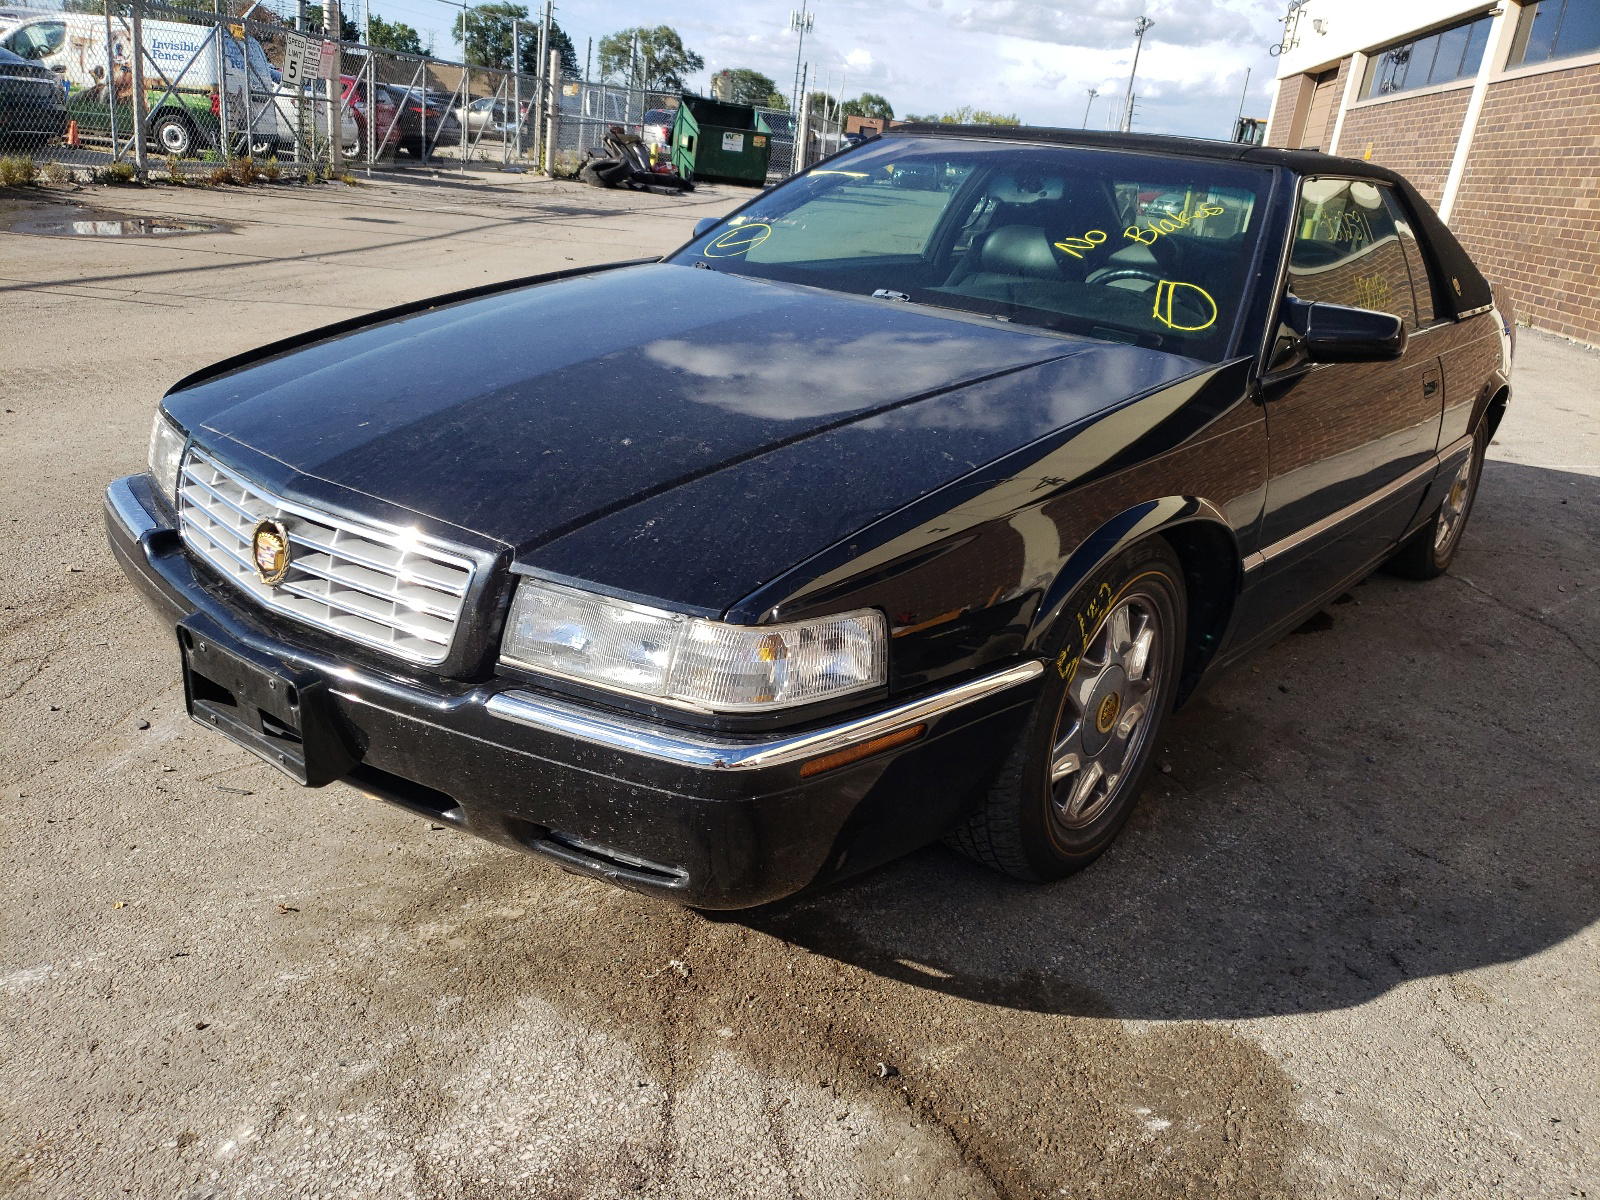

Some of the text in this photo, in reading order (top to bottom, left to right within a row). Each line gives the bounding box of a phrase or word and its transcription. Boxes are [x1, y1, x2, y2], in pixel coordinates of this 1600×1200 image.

[152, 38, 201, 53] Invisible
[287, 37, 305, 49] SPEED
[152, 49, 185, 62] Fence
[288, 48, 302, 60] LIMIT
[288, 60, 297, 78] 5
[1054, 230, 1107, 259] No
